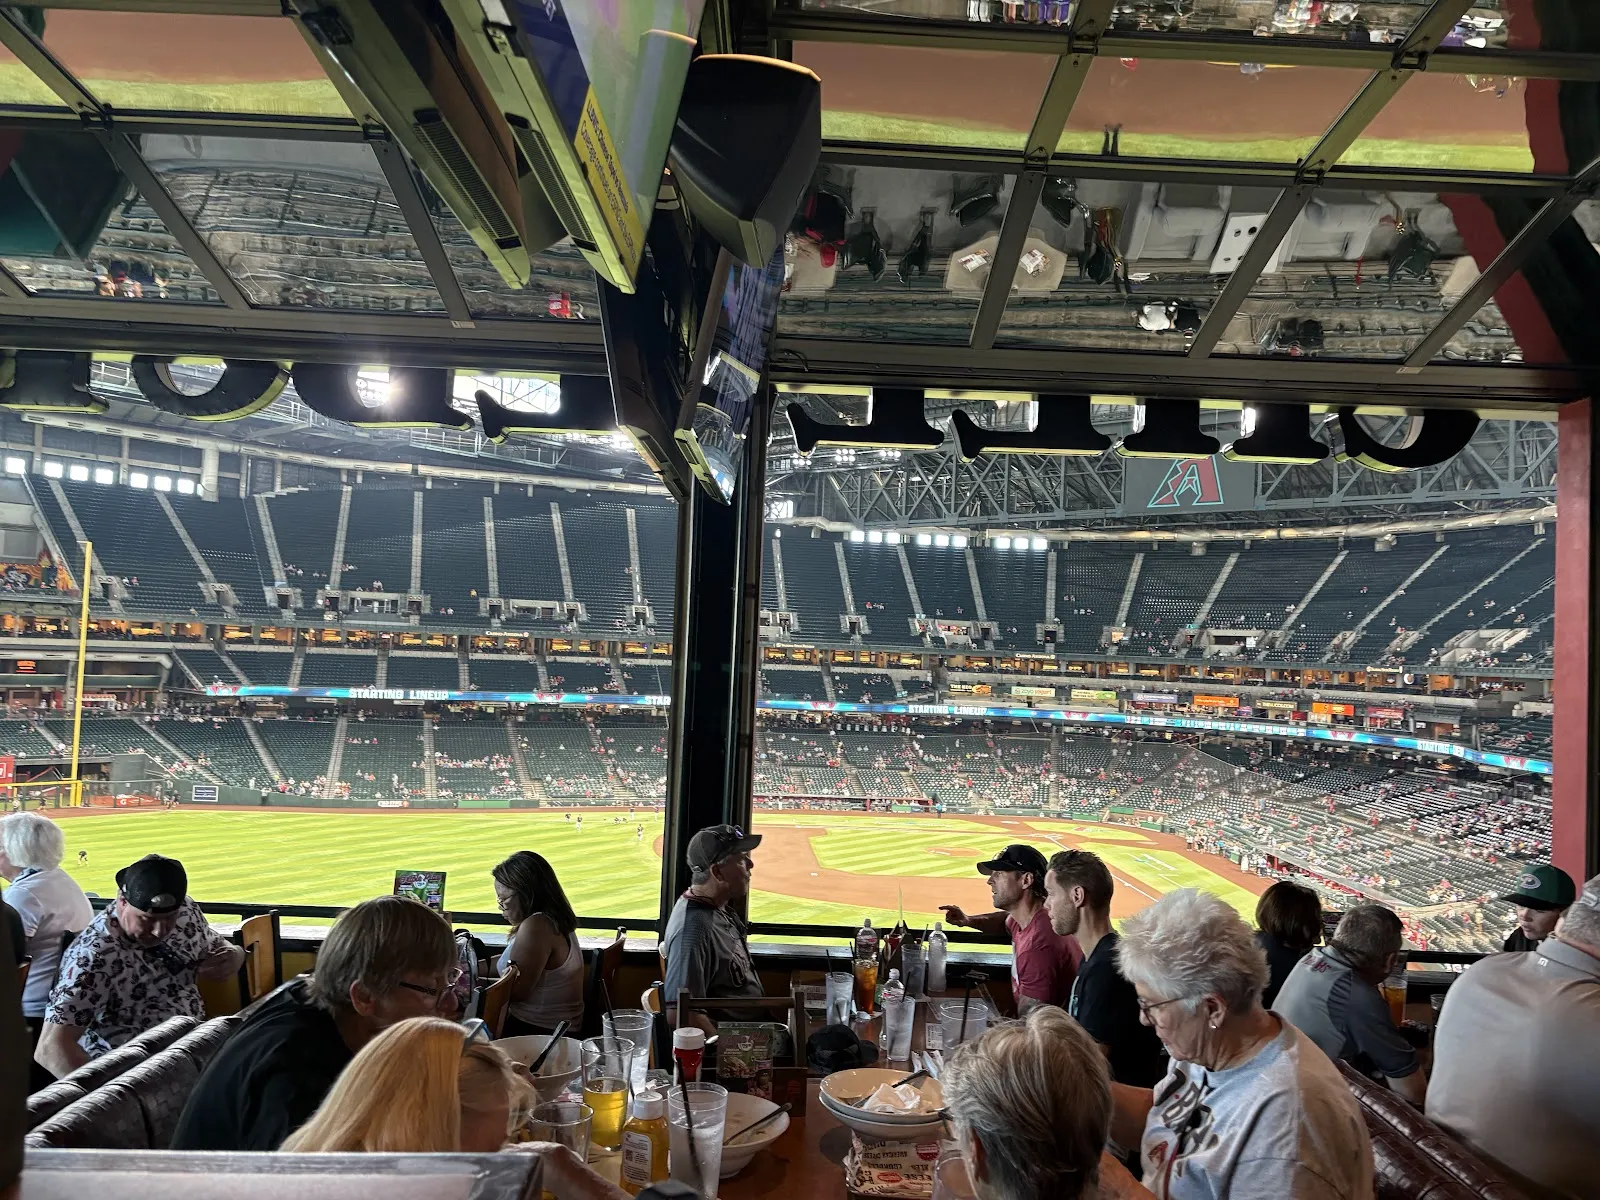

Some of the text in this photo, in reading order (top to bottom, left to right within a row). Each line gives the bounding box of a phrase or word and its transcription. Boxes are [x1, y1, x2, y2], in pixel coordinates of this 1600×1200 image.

[349, 688, 449, 701] STARTING LINEUP
[908, 704, 988, 716] STARTING LINEUP
